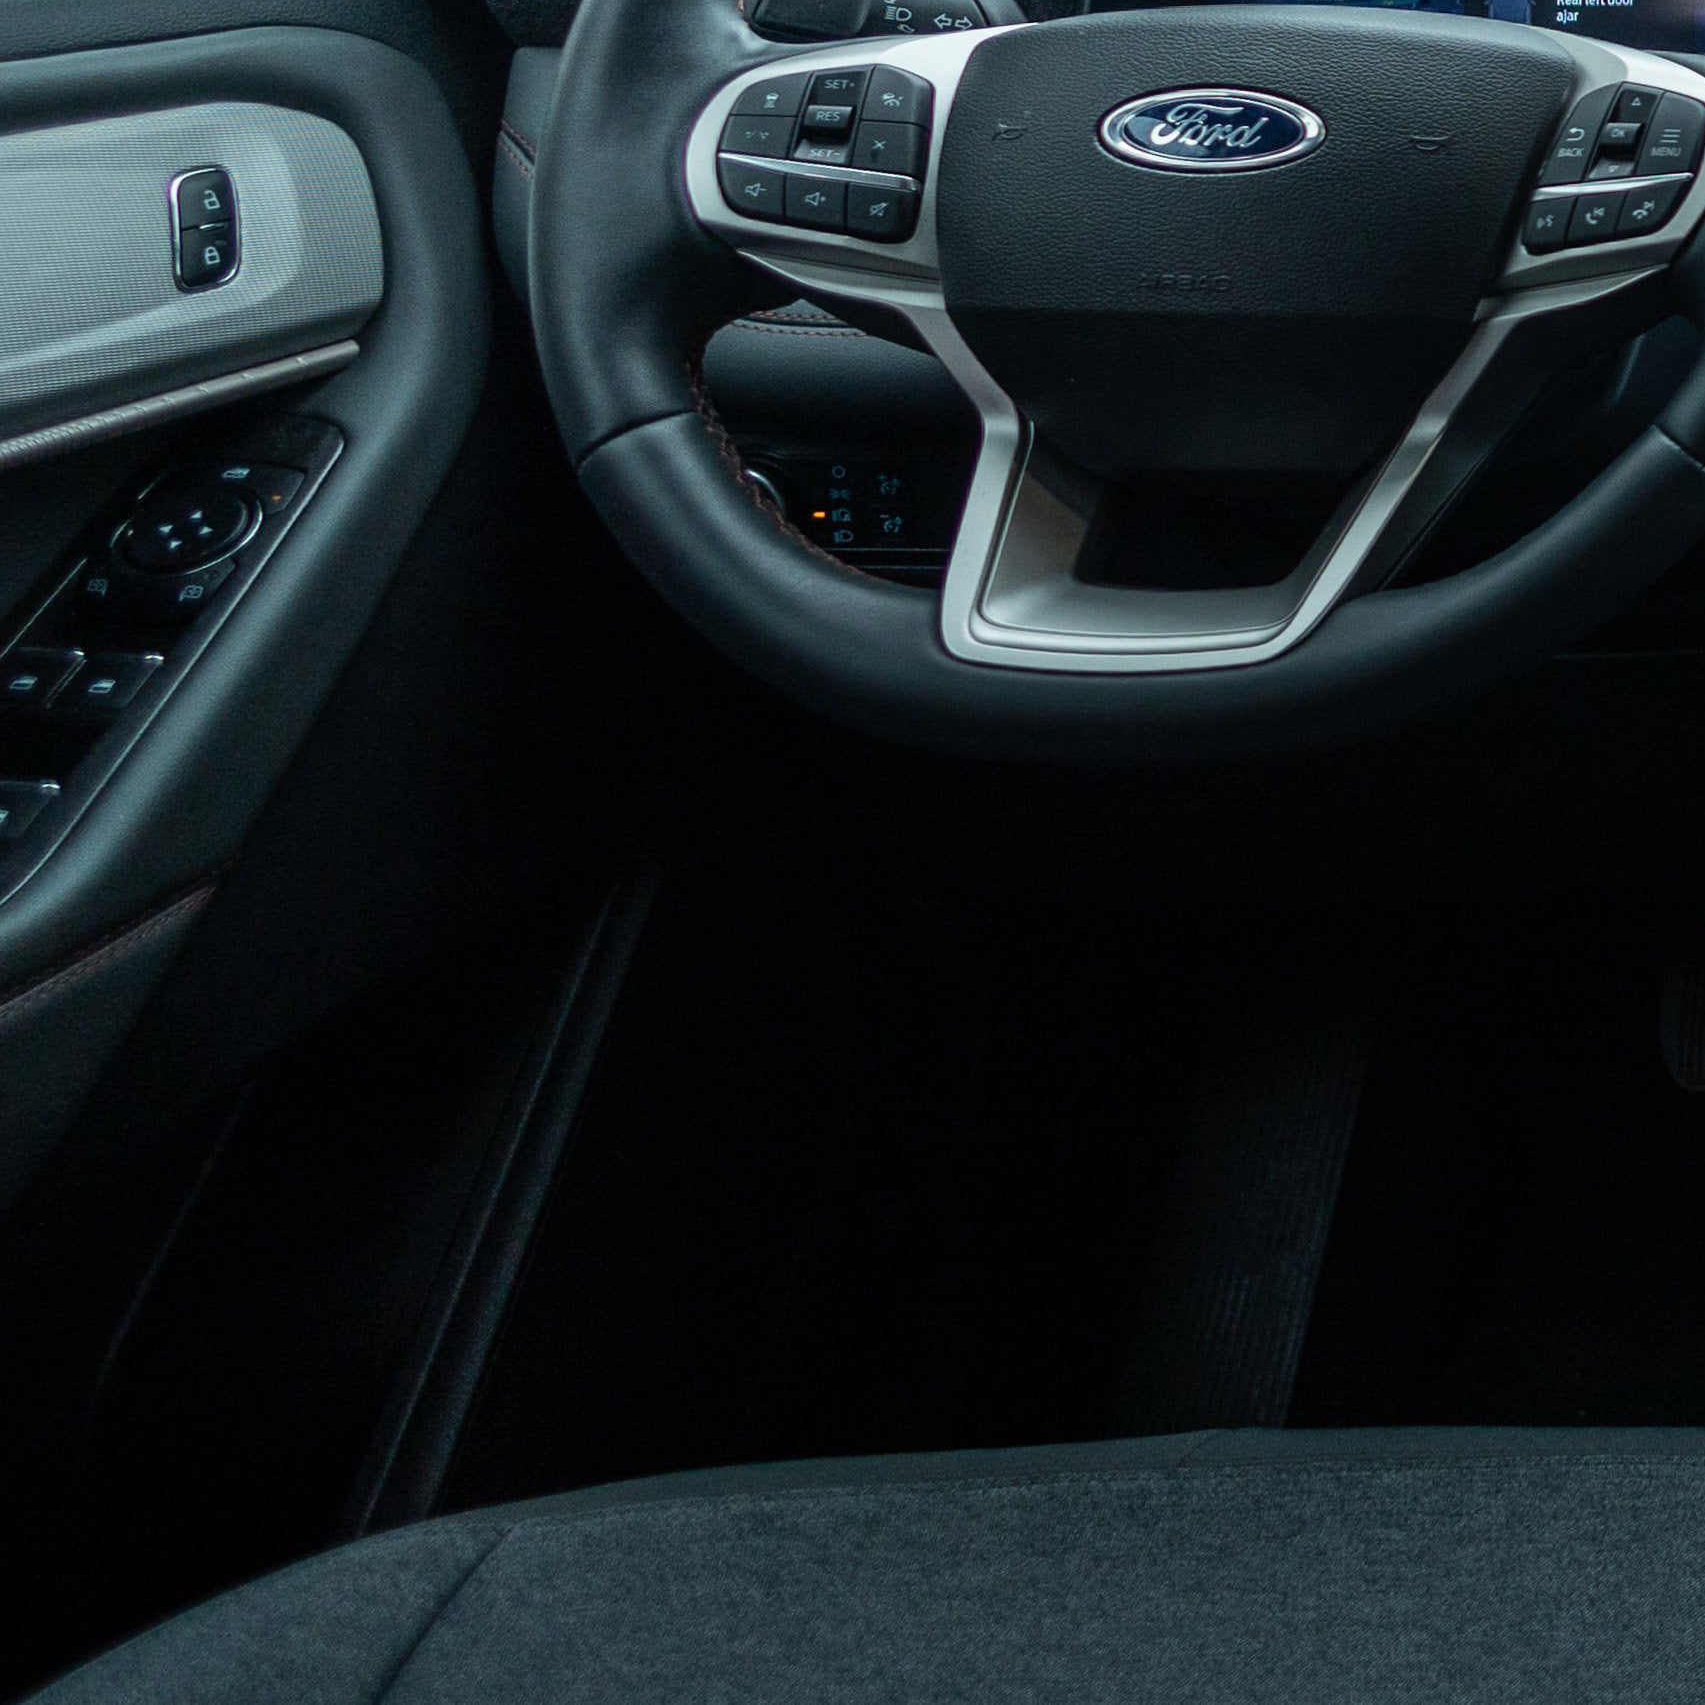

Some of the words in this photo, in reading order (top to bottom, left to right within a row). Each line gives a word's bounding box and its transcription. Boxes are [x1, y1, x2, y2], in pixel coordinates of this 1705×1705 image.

[1556, 9, 1579, 24] ajar
[815, 109, 841, 123] RES
[1152, 101, 1263, 147] Ford
[1557, 147, 1584, 158] BACK
[1650, 146, 1682, 158] MENU
